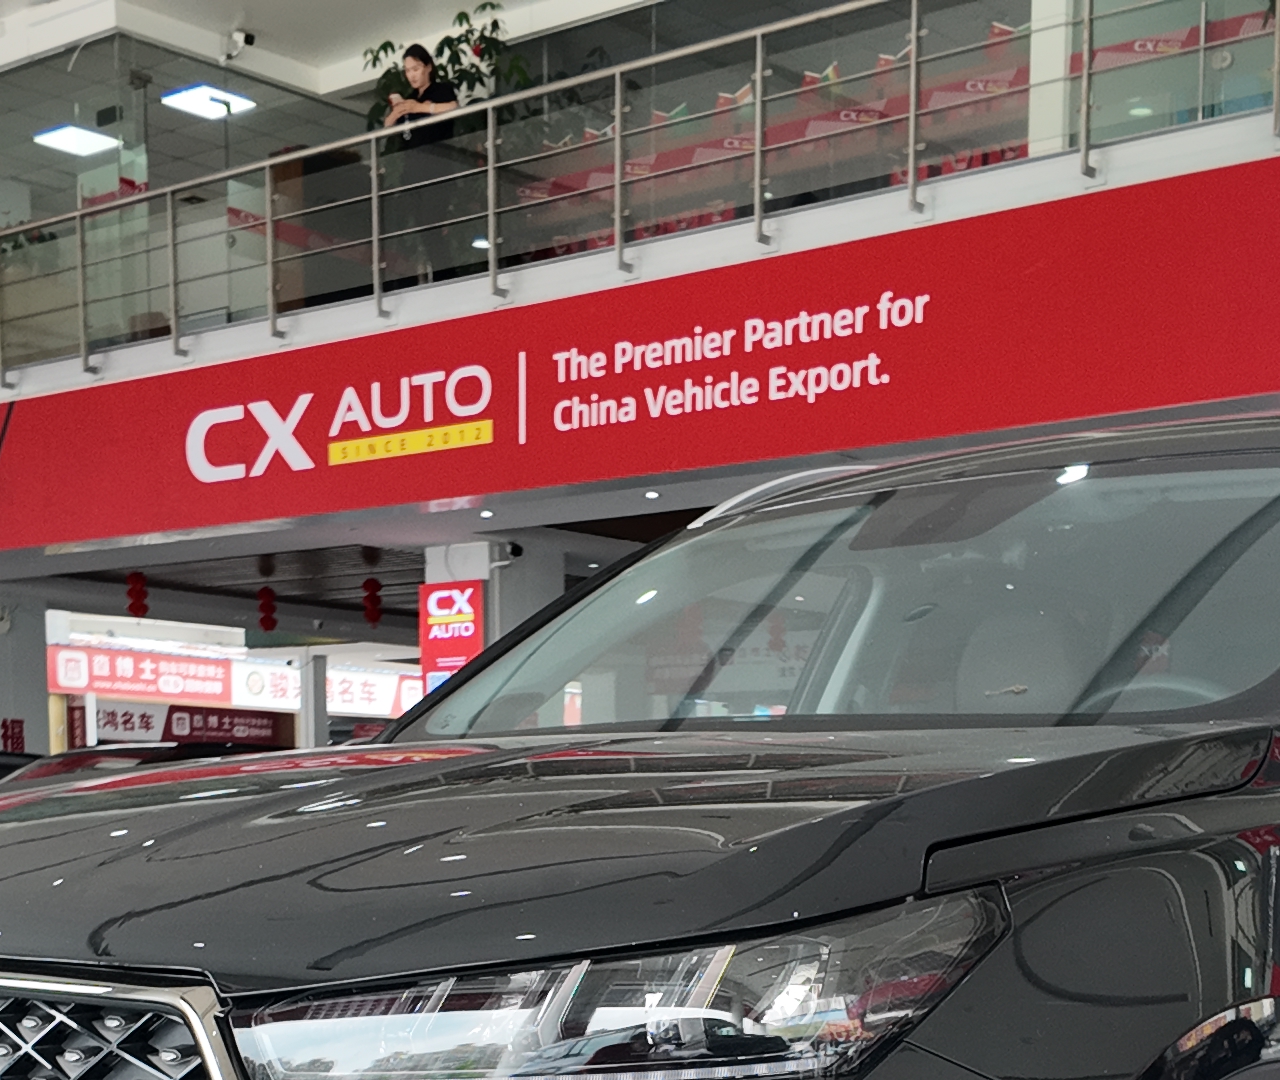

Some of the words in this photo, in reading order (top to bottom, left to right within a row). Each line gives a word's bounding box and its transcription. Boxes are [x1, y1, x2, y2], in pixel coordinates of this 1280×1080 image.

[552, 347, 607, 383] The
[614, 325, 736, 374] Premier
[744, 304, 870, 352] Partner
[877, 290, 930, 330] for
[553, 393, 637, 432] China
[644, 371, 760, 419] Vehicle
[768, 352, 890, 404] Export.
[185, 392, 316, 484] CX
[328, 364, 492, 437] AUTO
[340, 438, 408, 460] SINCE
[426, 427, 483, 448] 2012
[427, 588, 474, 616] CX
[428, 622, 475, 639] AUTO
[96, 708, 155, 734] 鸿名车
